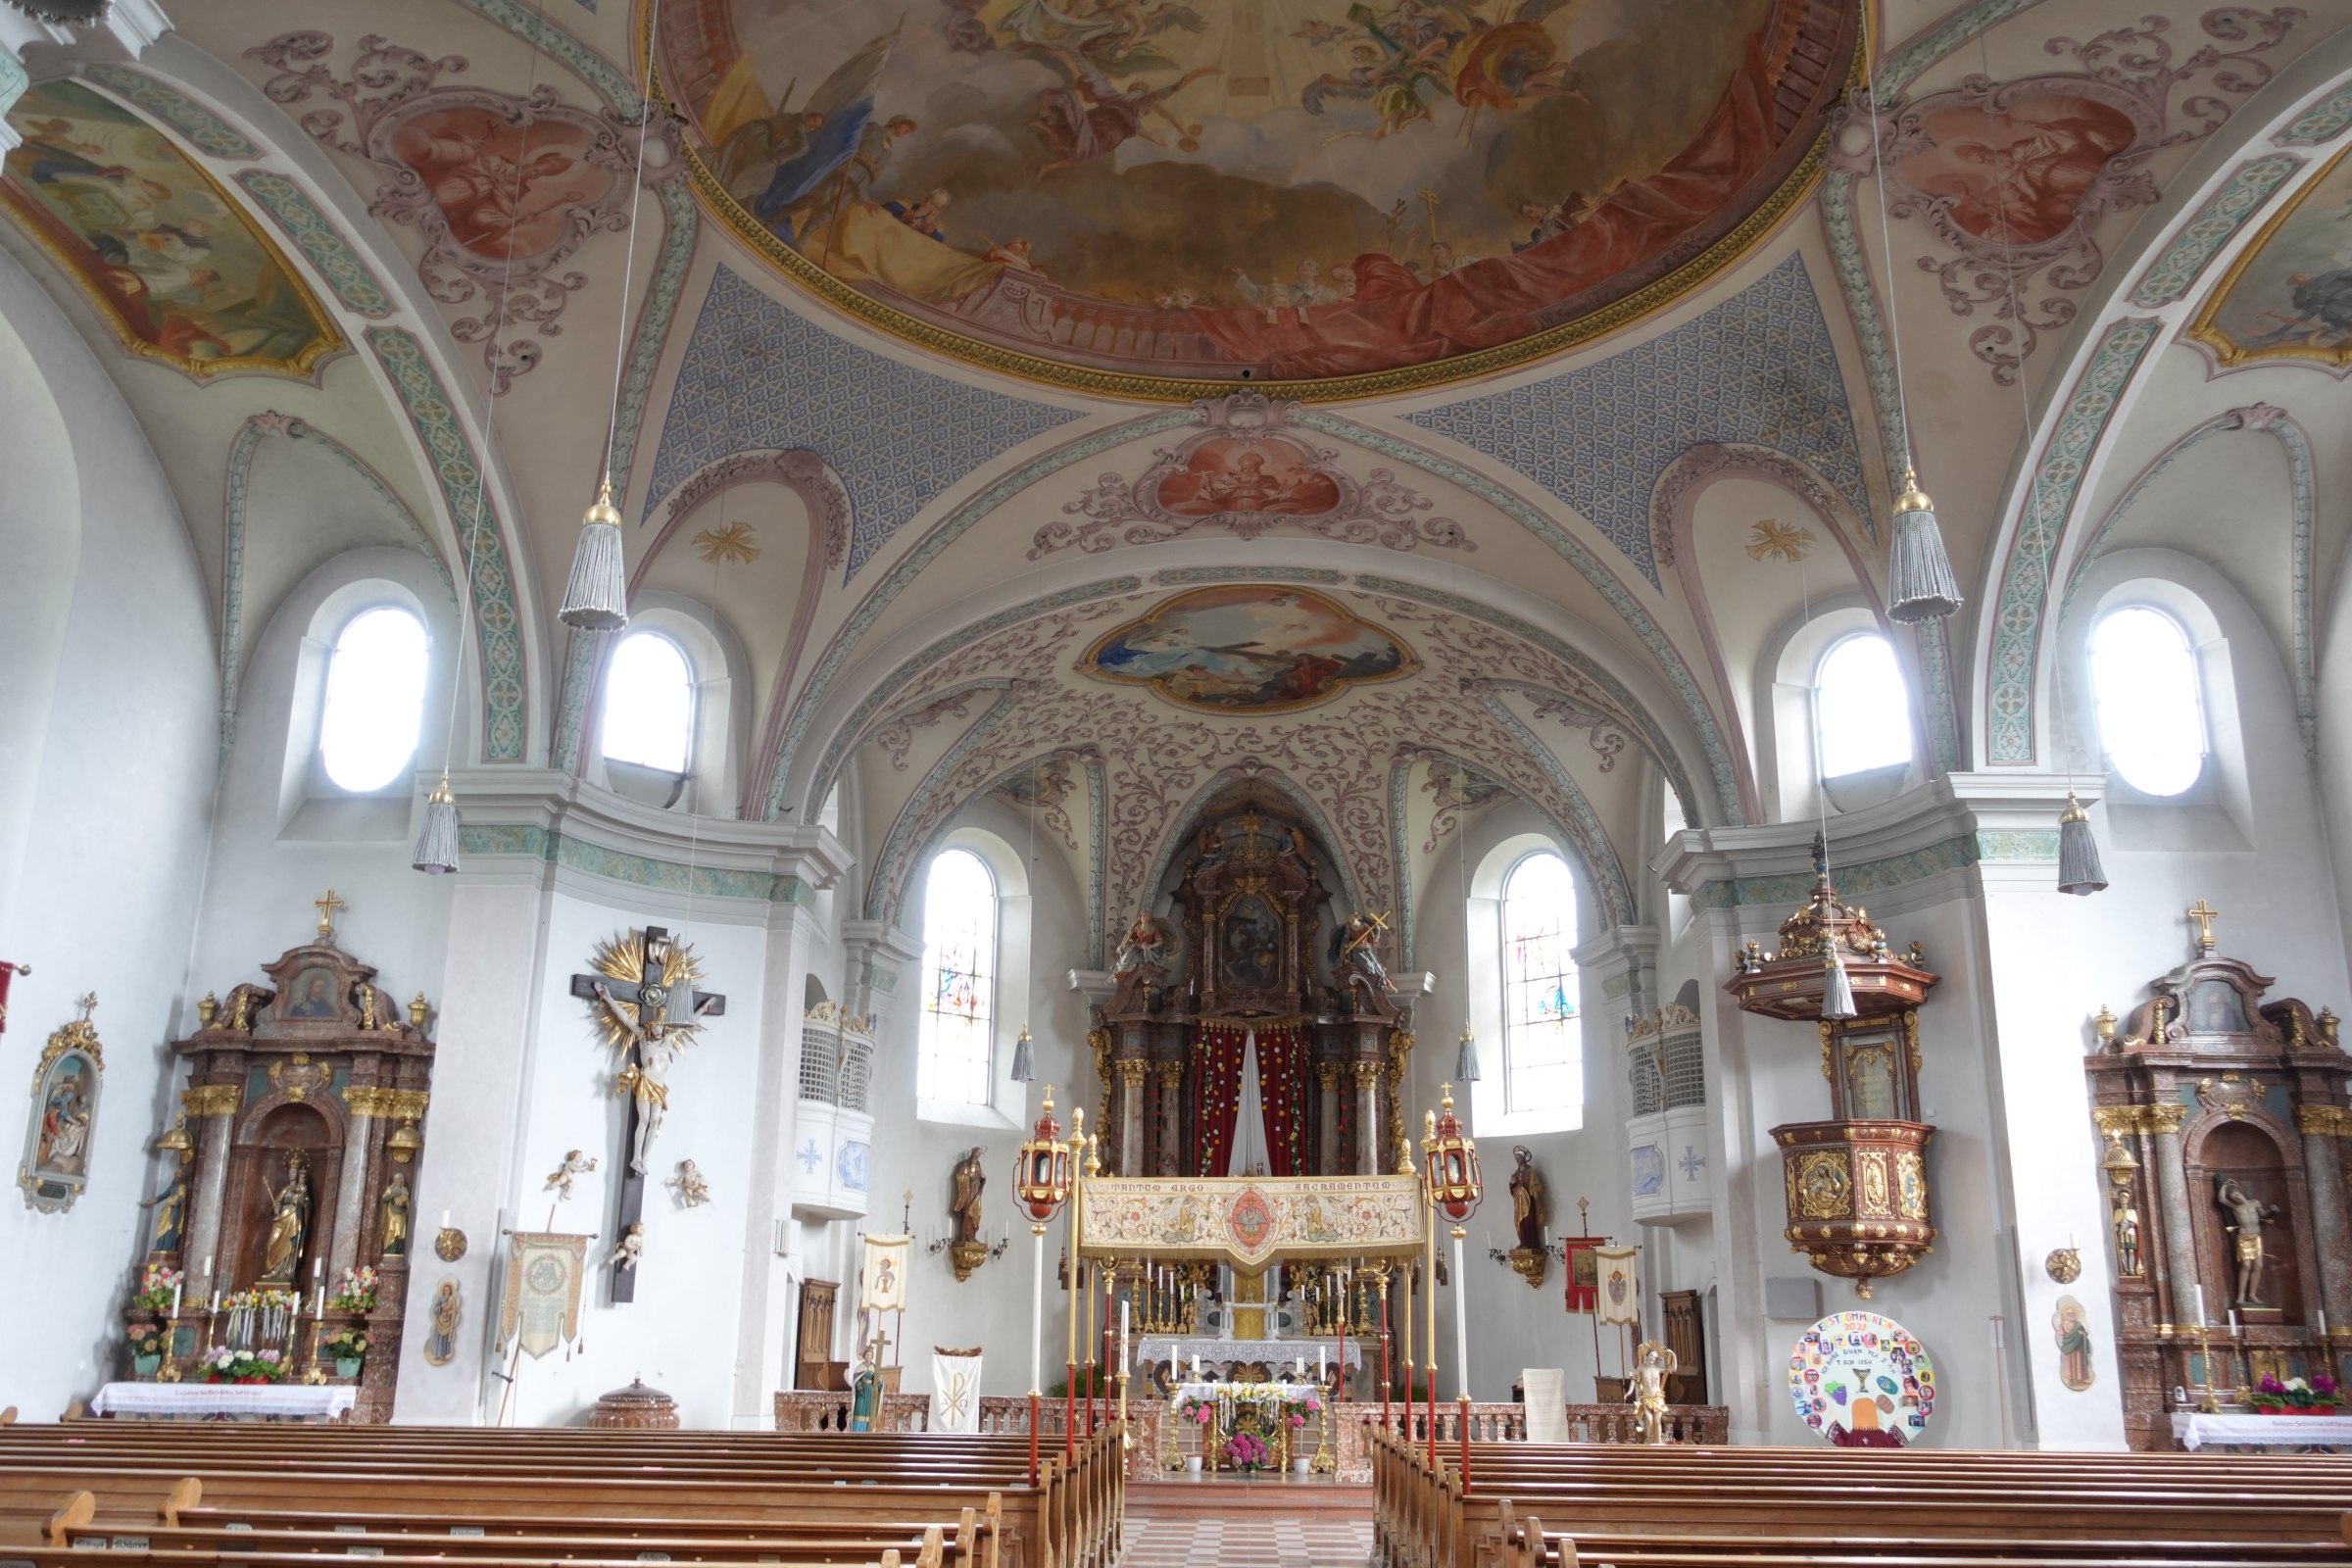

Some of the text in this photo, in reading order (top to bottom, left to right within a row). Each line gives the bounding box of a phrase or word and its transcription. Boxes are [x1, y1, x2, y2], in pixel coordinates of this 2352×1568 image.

[1171, 1184, 1204, 1193] ERGO
[1295, 1182, 1391, 1192] SACRAMENTUM
[1843, 1322, 1867, 1332] 2021
